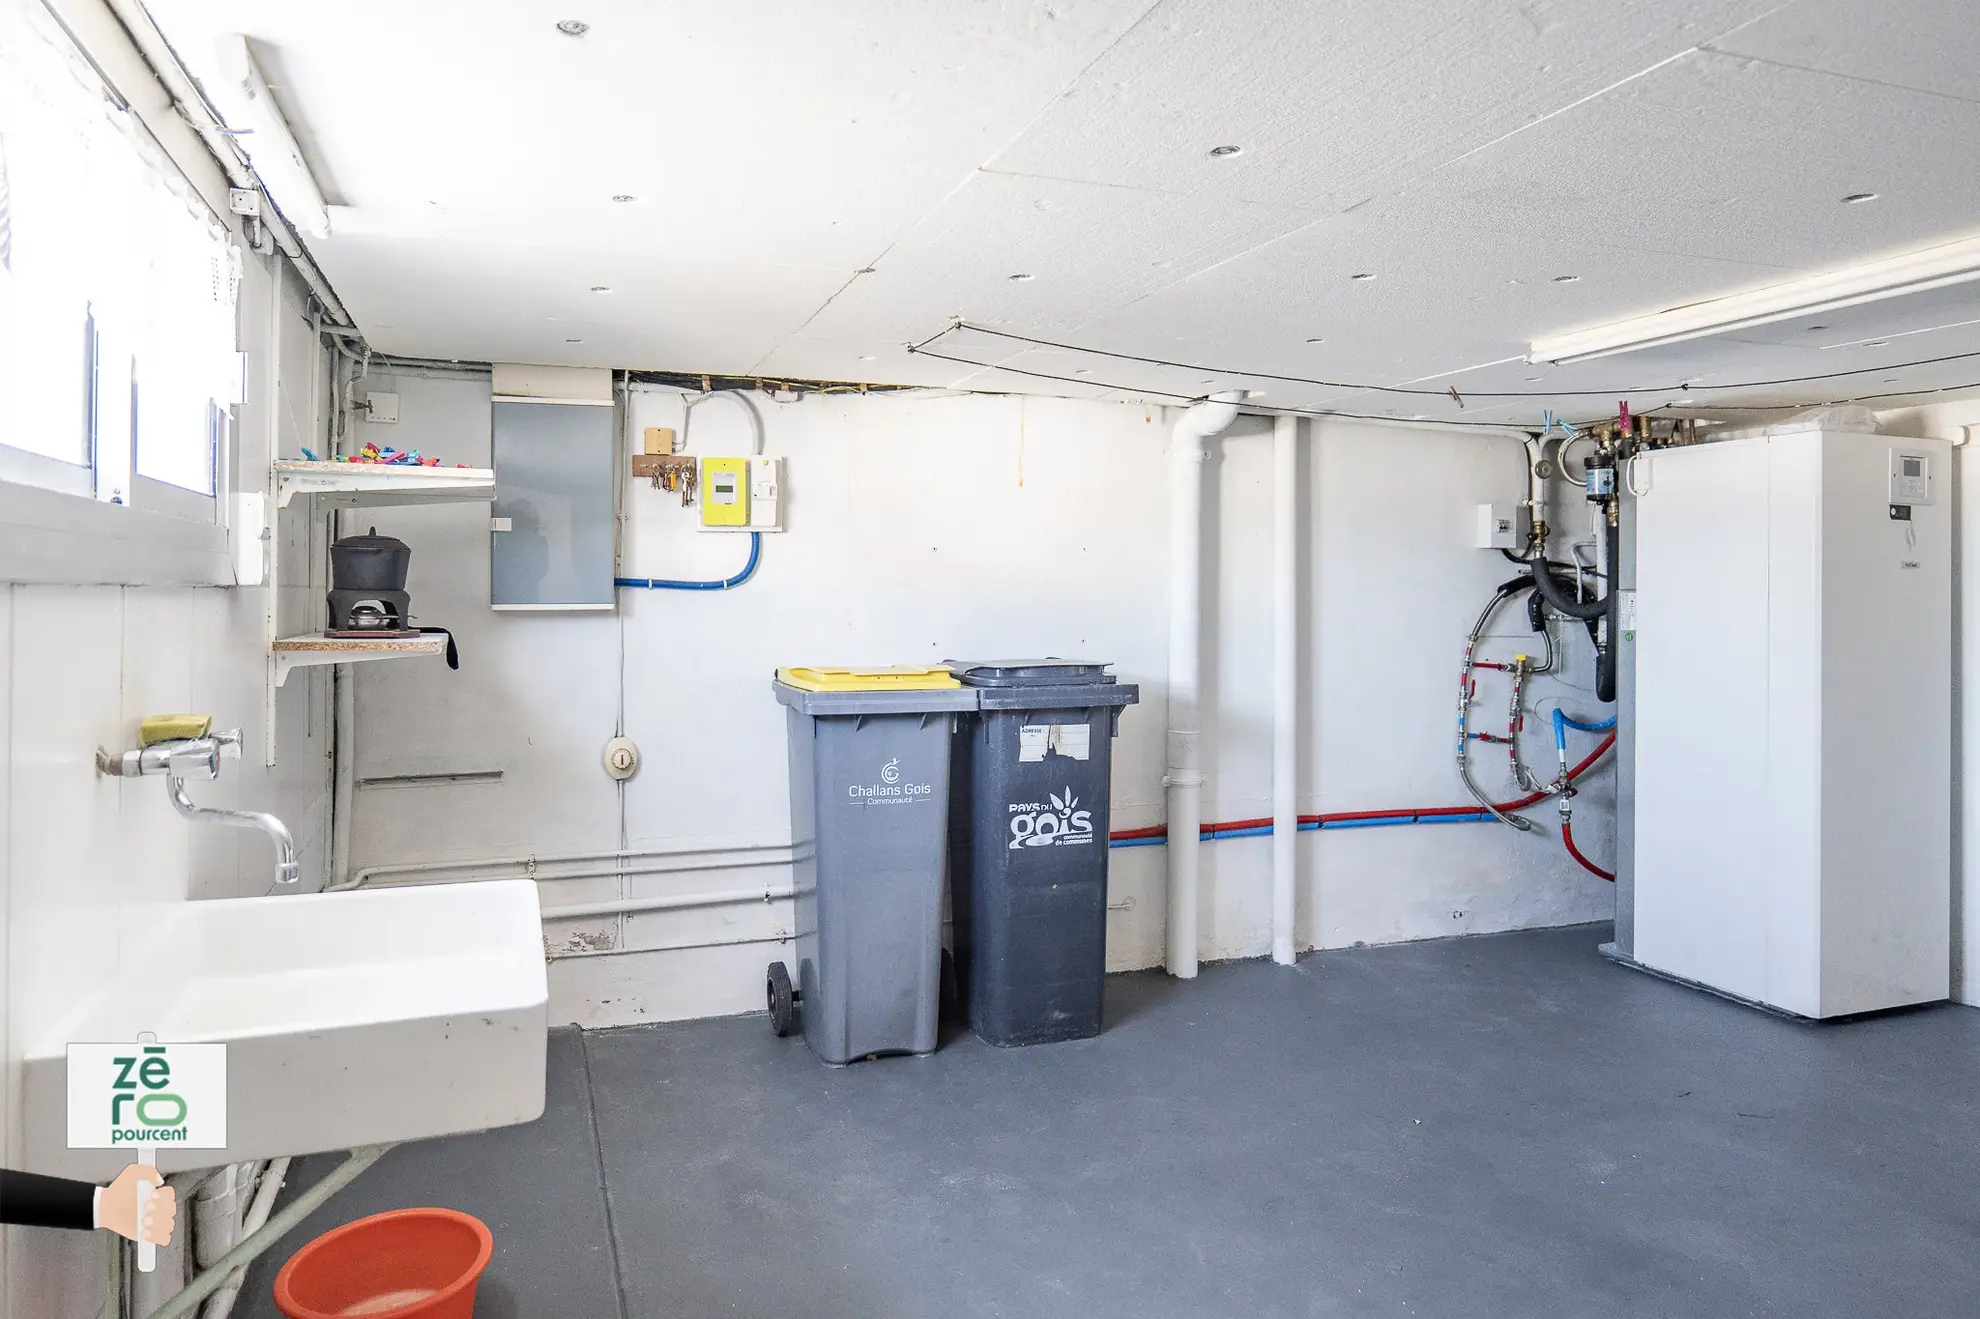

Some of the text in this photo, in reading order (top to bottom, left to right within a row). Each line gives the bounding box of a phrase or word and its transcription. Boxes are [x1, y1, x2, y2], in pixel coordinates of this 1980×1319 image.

[848, 783, 931, 797] Challans Gois
[867, 796, 913, 805] Communauté
[1009, 810, 1093, 850] gois
